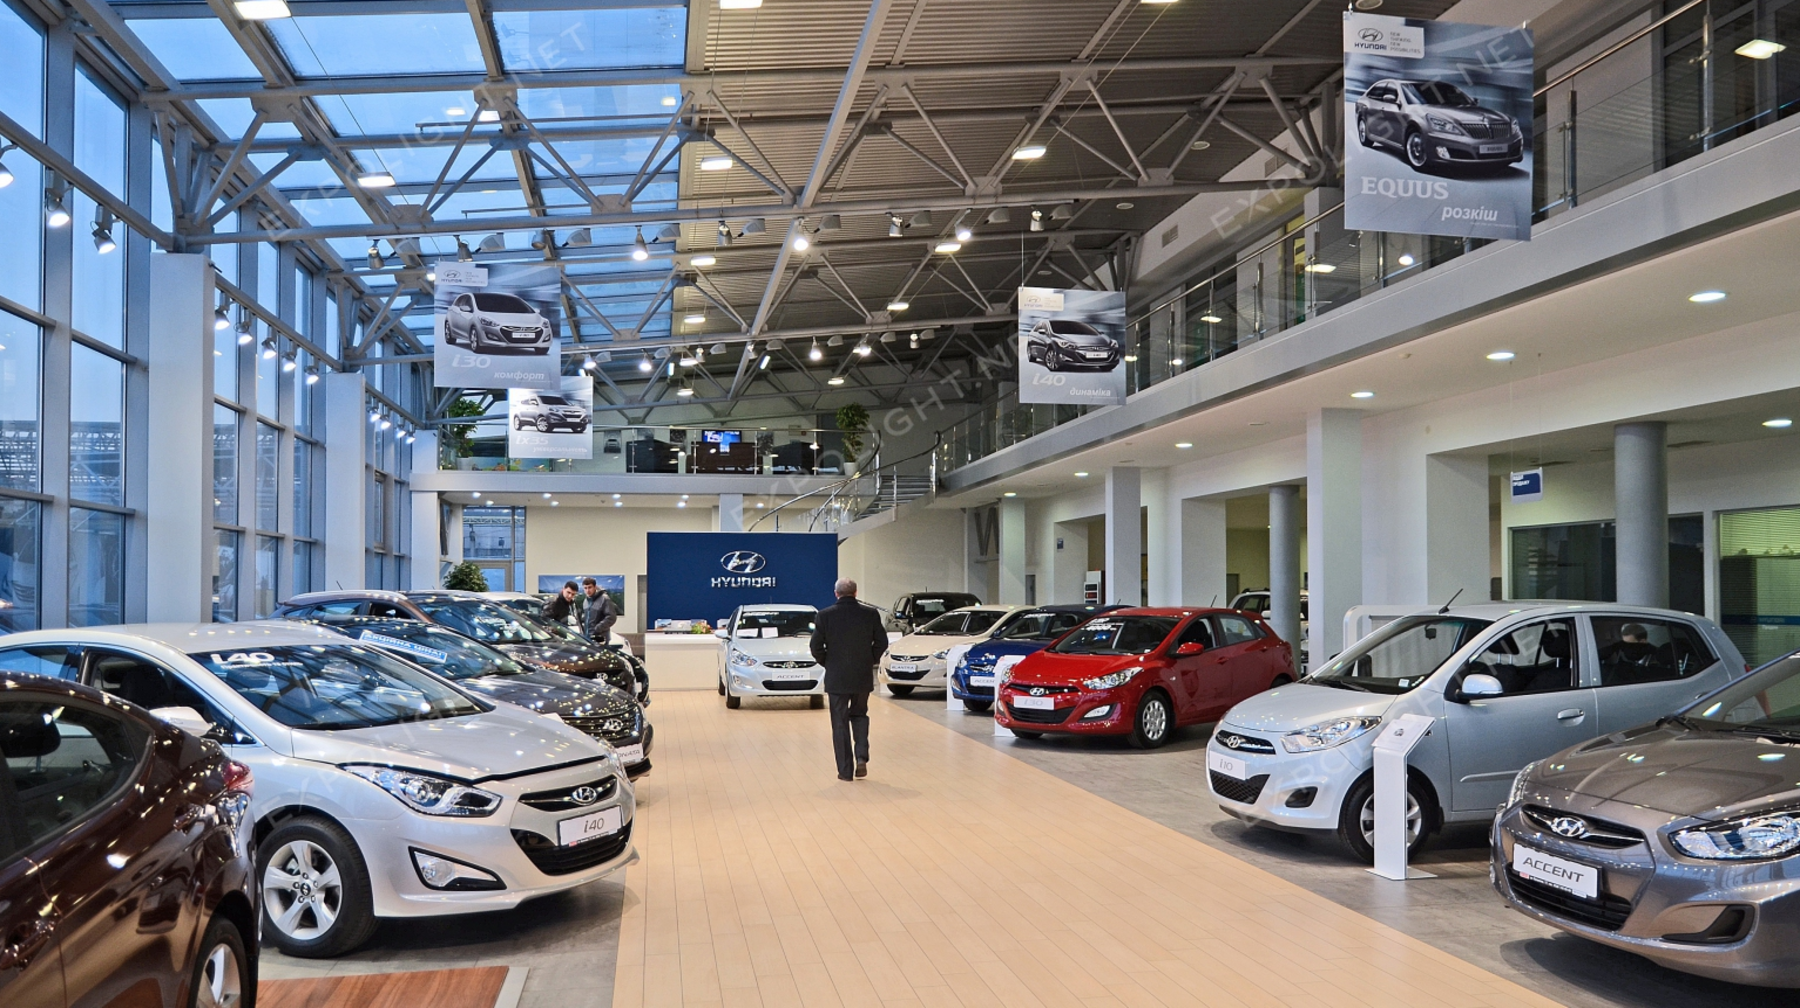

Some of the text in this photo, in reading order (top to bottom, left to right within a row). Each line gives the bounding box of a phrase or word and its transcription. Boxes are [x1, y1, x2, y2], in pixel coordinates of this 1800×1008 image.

[1354, 42, 1388, 50] HYUNDAI
[1361, 176, 1449, 200] EQUUS
[1441, 206, 1498, 221] розкіш
[452, 354, 491, 368] i30
[494, 371, 545, 381] комфорт
[1032, 373, 1066, 386] i40
[1069, 387, 1111, 397] динаміка
[711, 577, 777, 588] HYUNDAI
[1023, 698, 1044, 706] i30
[1219, 759, 1233, 772] i10
[583, 817, 605, 834] i40
[1522, 856, 1584, 883] ACCENT
